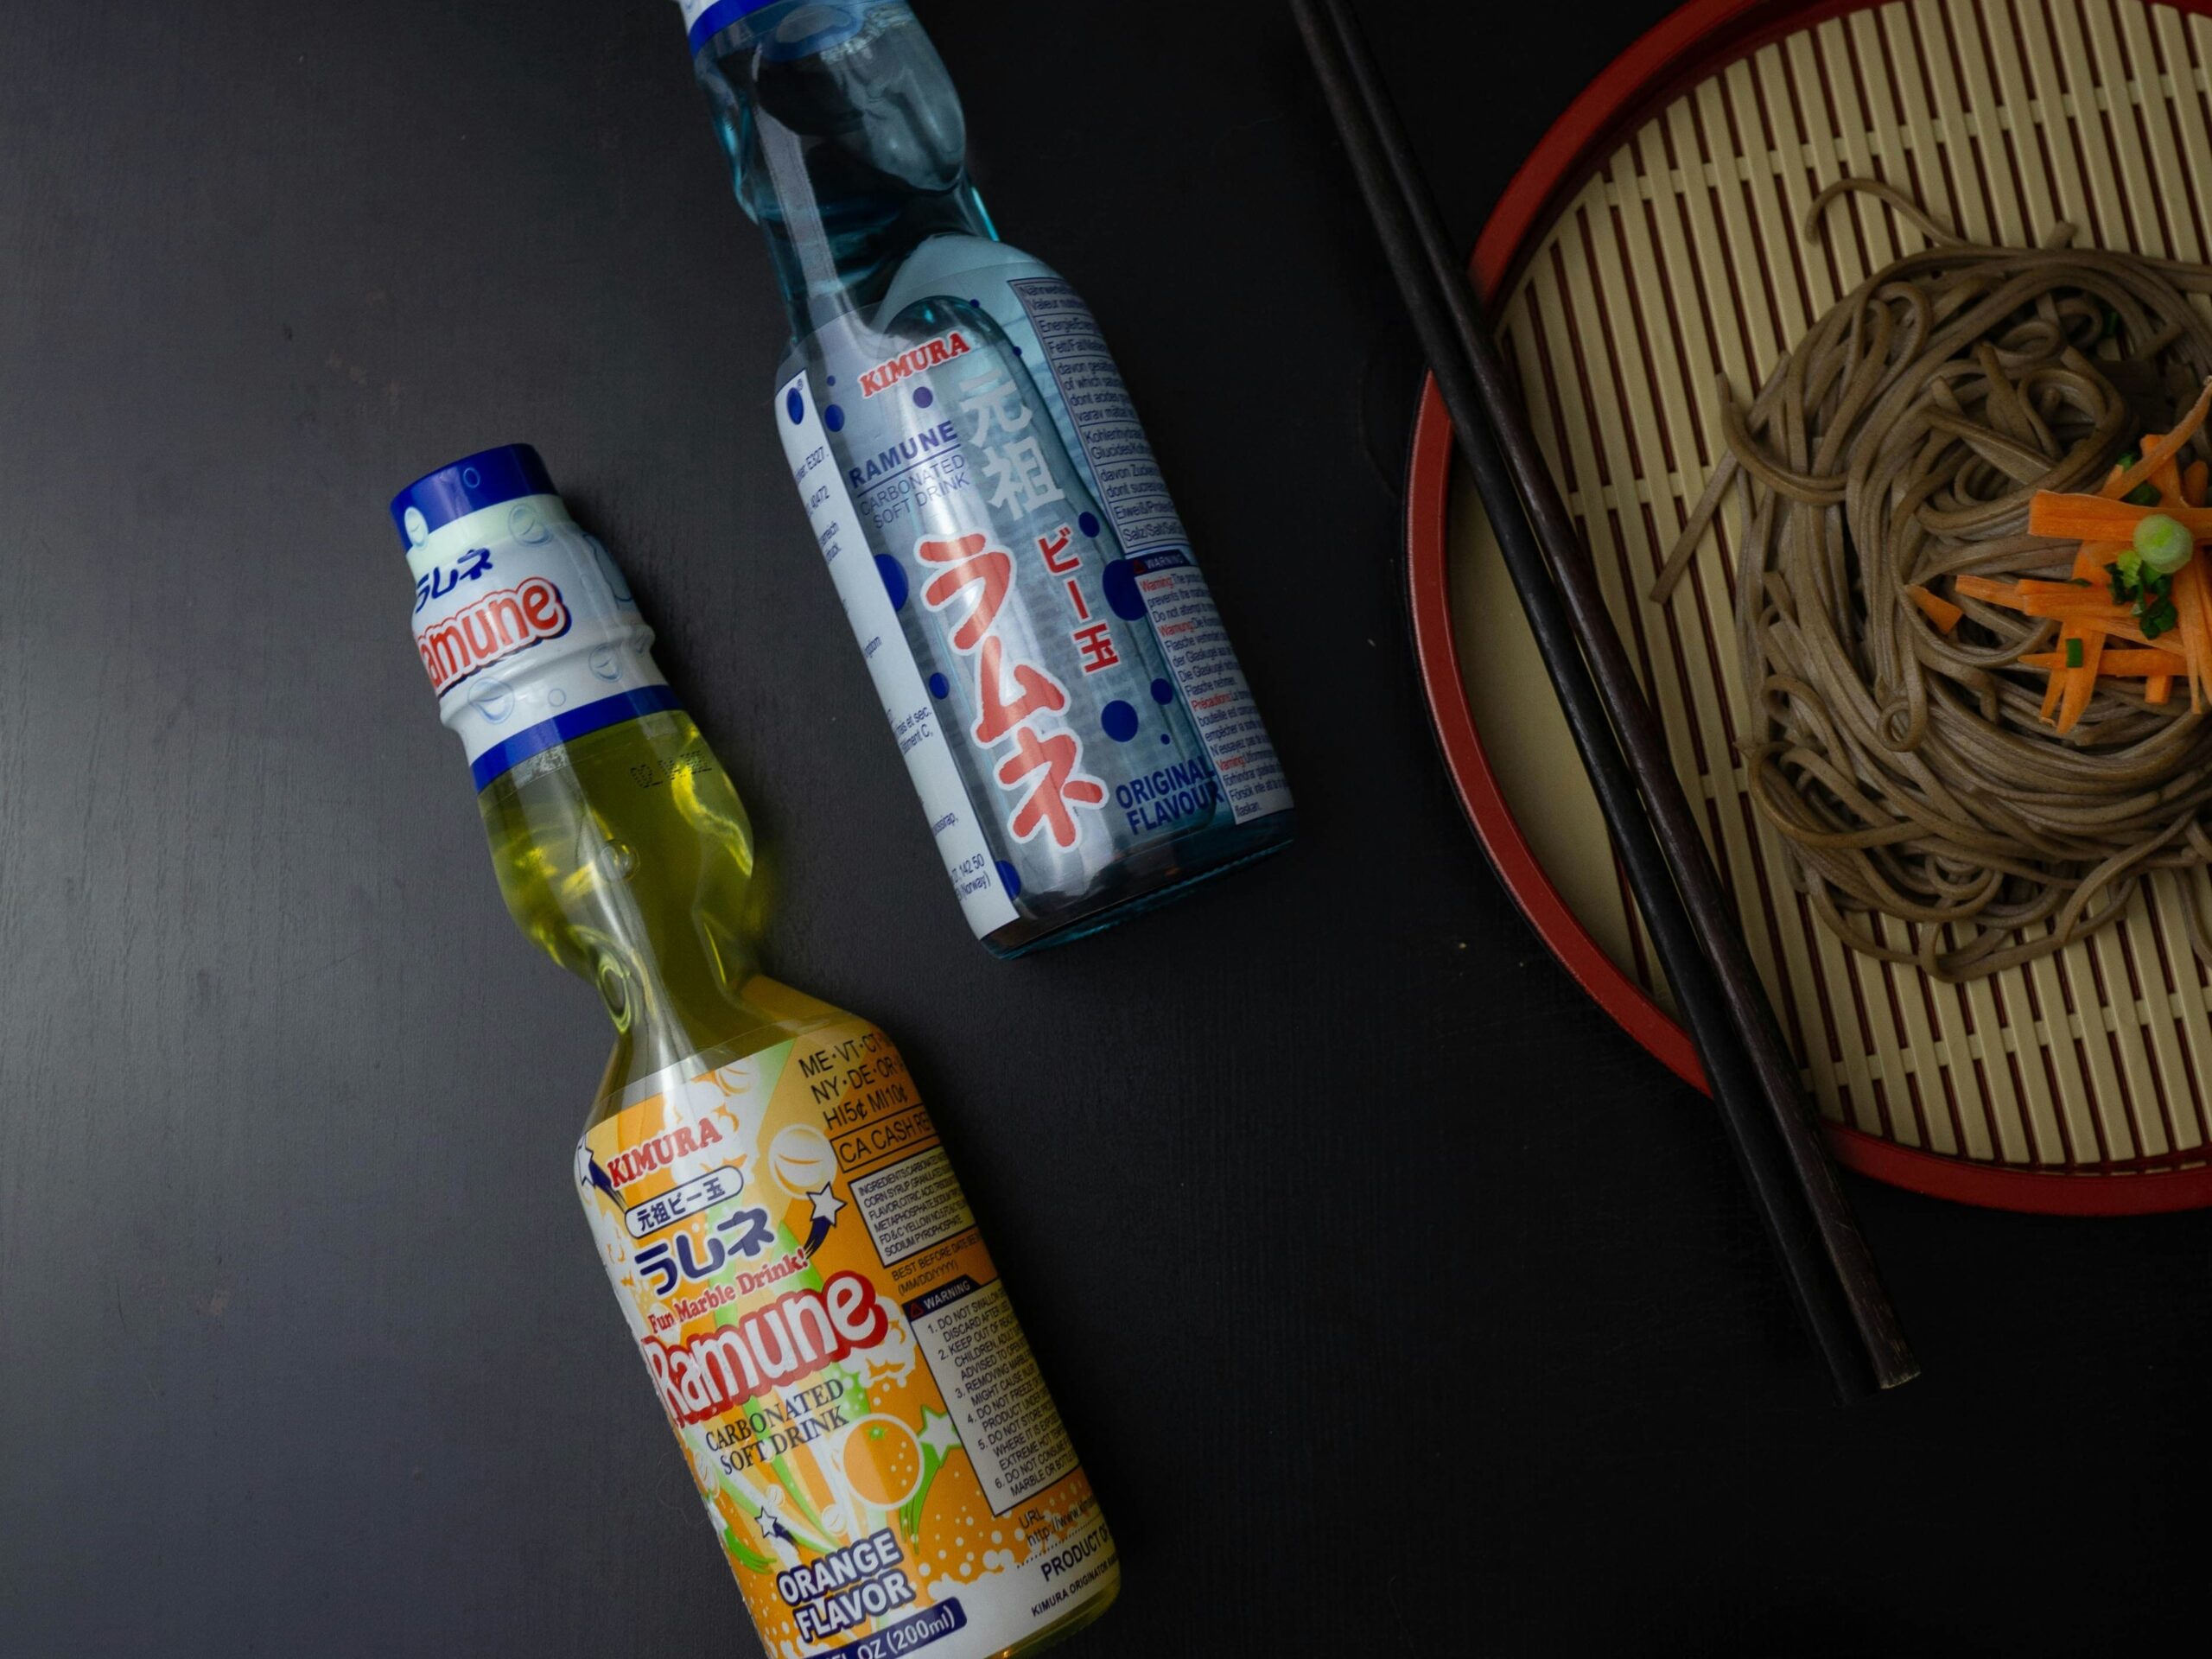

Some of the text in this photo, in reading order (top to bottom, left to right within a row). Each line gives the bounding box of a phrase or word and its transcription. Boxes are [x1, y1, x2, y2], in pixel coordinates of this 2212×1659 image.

[859, 333, 970, 397] KIMURA
[849, 421, 957, 488] RAMUNE
[859, 454, 966, 516] CARBONATED
[1101, 467, 1131, 481] davon
[874, 473, 969, 529] SOFT DRINK
[417, 582, 563, 691] amune
[918, 532, 1104, 848] ラムネ
[1116, 756, 1215, 809] ORIGINAL
[1127, 779, 1224, 835] FLAVOUR
[823, 1099, 868, 1130] HI5¢
[607, 1117, 722, 1188] KIMURA
[839, 1119, 914, 1163] CA CASH
[637, 1177, 726, 1232] 元祖ビー玉
[864, 1192, 887, 1208] CORN
[904, 1214, 931, 1234] YELLOW
[885, 1236, 916, 1257] SODIUM
[892, 1260, 918, 1281] BEST
[918, 1247, 952, 1268] BEFORE
[648, 1249, 809, 1334] Fun Marble Drink!
[924, 1281, 971, 1310] WARNING
[928, 1323, 938, 1334] 1.
[938, 1314, 953, 1331] DO
[953, 1306, 972, 1323] NOT
[943, 1316, 982, 1343] DISCARD
[643, 1273, 883, 1426] Ramune
[938, 1349, 950, 1361] 2.
[949, 1334, 975, 1356] KEEP
[974, 1326, 990, 1343] OUT
[955, 1388, 966, 1399] 3.
[965, 1364, 1010, 1393] REMOVING
[961, 1356, 997, 1381] ADVISED
[996, 1349, 1007, 1363] TO
[970, 1382, 1001, 1407] MIGHT
[1001, 1372, 1024, 1390] CAUSE
[705, 1378, 843, 1452] CARBONATED
[967, 1413, 977, 1424] 4.
[976, 1403, 993, 1420] DO
[993, 1394, 1012, 1411] NOT
[982, 1401, 1022, 1433] PRODUCT
[720, 1403, 849, 1475] SOFT DRINK
[977, 1439, 988, 1451] 5.
[988, 1428, 1004, 1446] DO
[1003, 1419, 1022, 1435] NOT
[993, 1435, 1027, 1458] WHERE
[1027, 1428, 1033, 1441] IT
[995, 1478, 1006, 1489] 6.
[1004, 1469, 1020, 1484] DO
[1020, 1459, 1038, 1476] NOT
[999, 1443, 1039, 1471] EXTREME
[1010, 1474, 1046, 1497] MARBLE
[1045, 1464, 1057, 1477] OR
[1018, 1508, 1046, 1529] URL
[778, 1529, 903, 1605] ORANGE
[1040, 1530, 1102, 1582] PRODUCT
[793, 1570, 915, 1642] FLAVOR
[1031, 1564, 1108, 1617] KIMURA ORIGINATOR
[857, 1605, 955, 1659] OZ (200ml)
